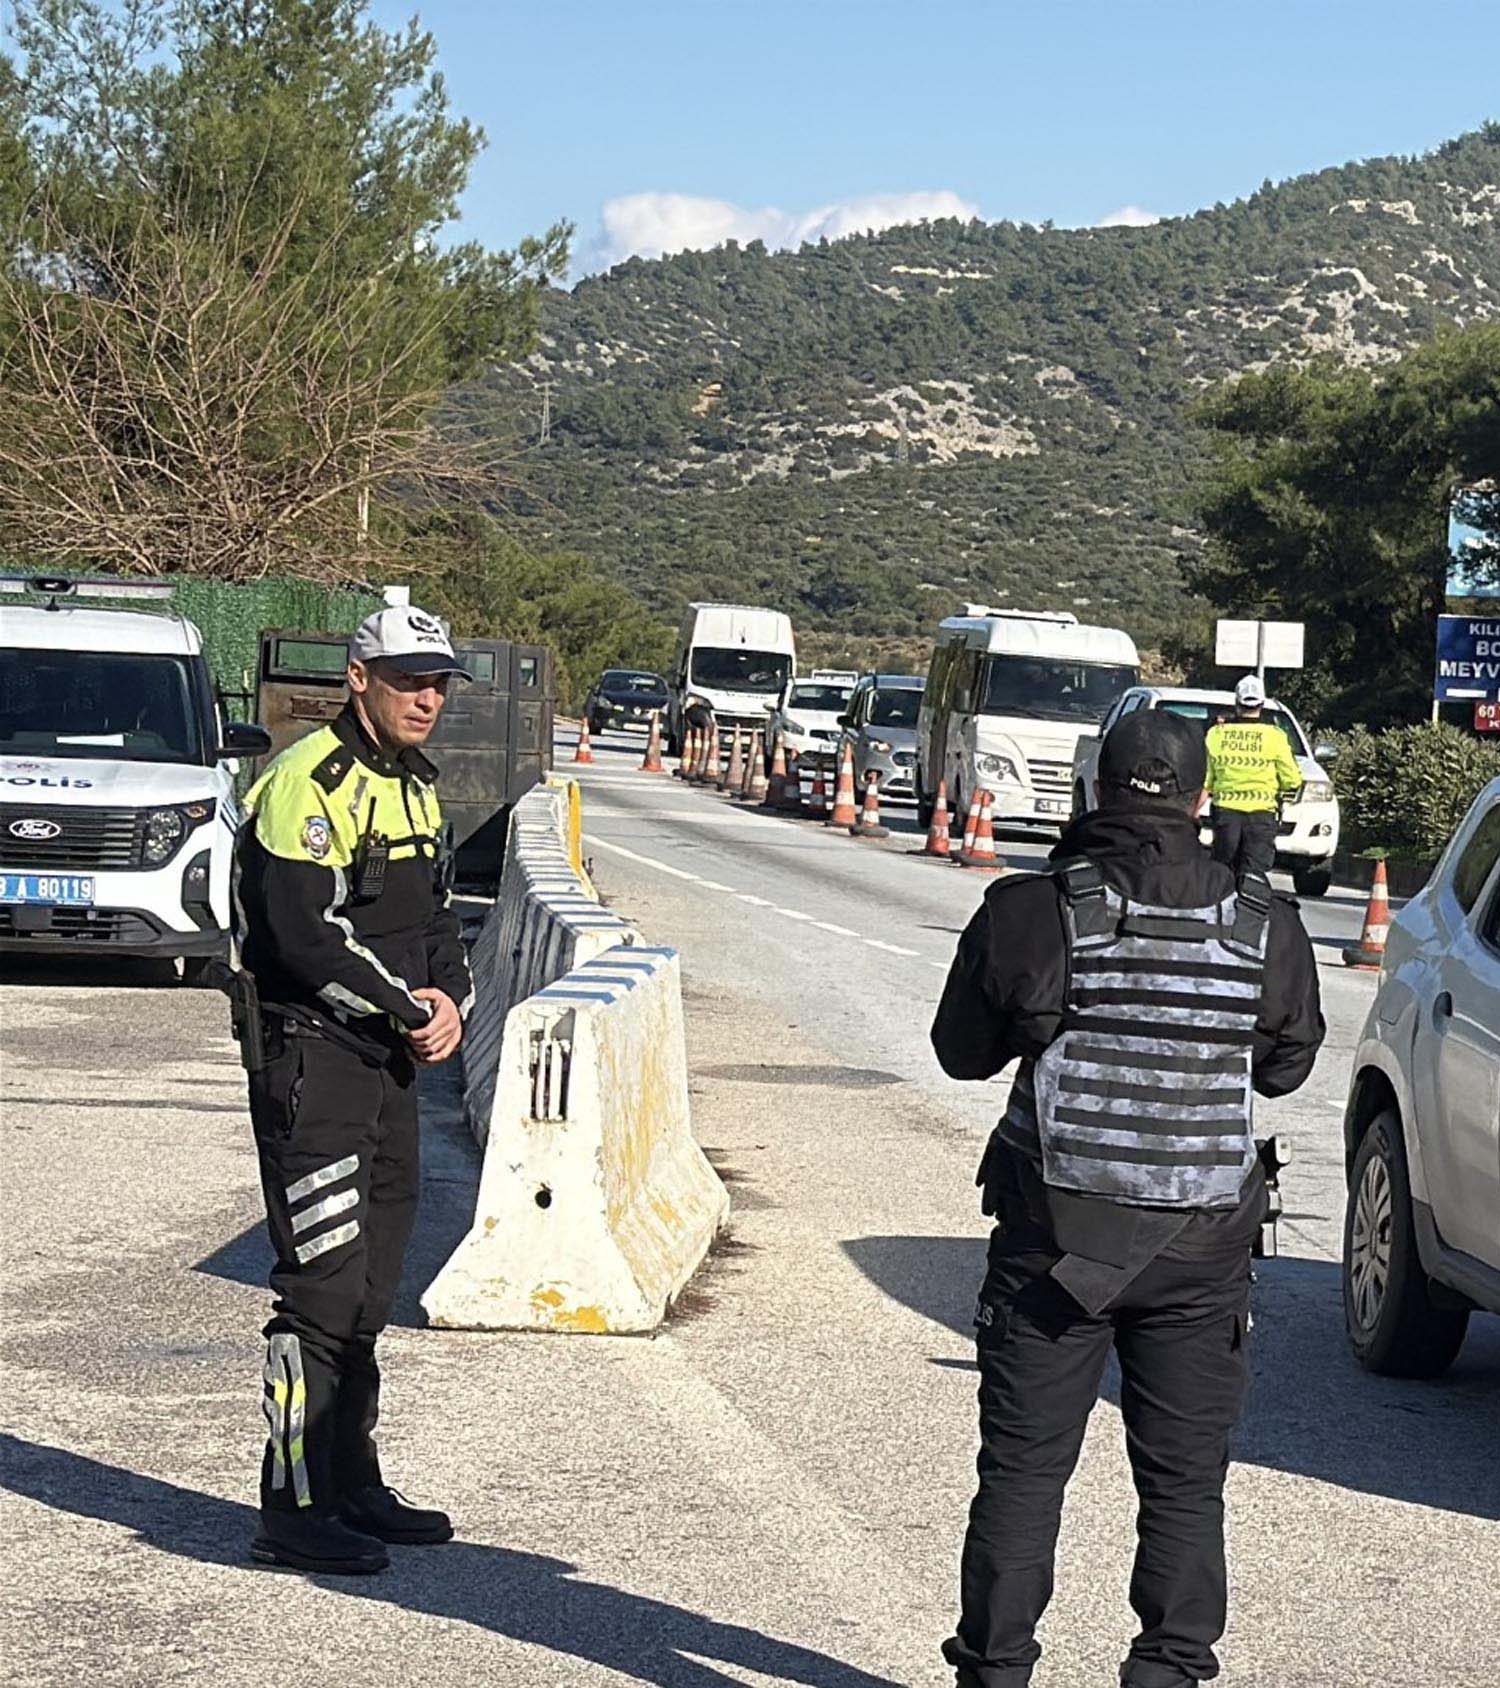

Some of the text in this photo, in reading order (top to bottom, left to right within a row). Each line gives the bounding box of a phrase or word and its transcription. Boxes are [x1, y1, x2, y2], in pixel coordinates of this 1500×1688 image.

[1478, 706, 1495, 719] 60
[0, 776, 93, 788] OLİS
[17, 877, 27, 897] A
[38, 877, 92, 899] 80119
